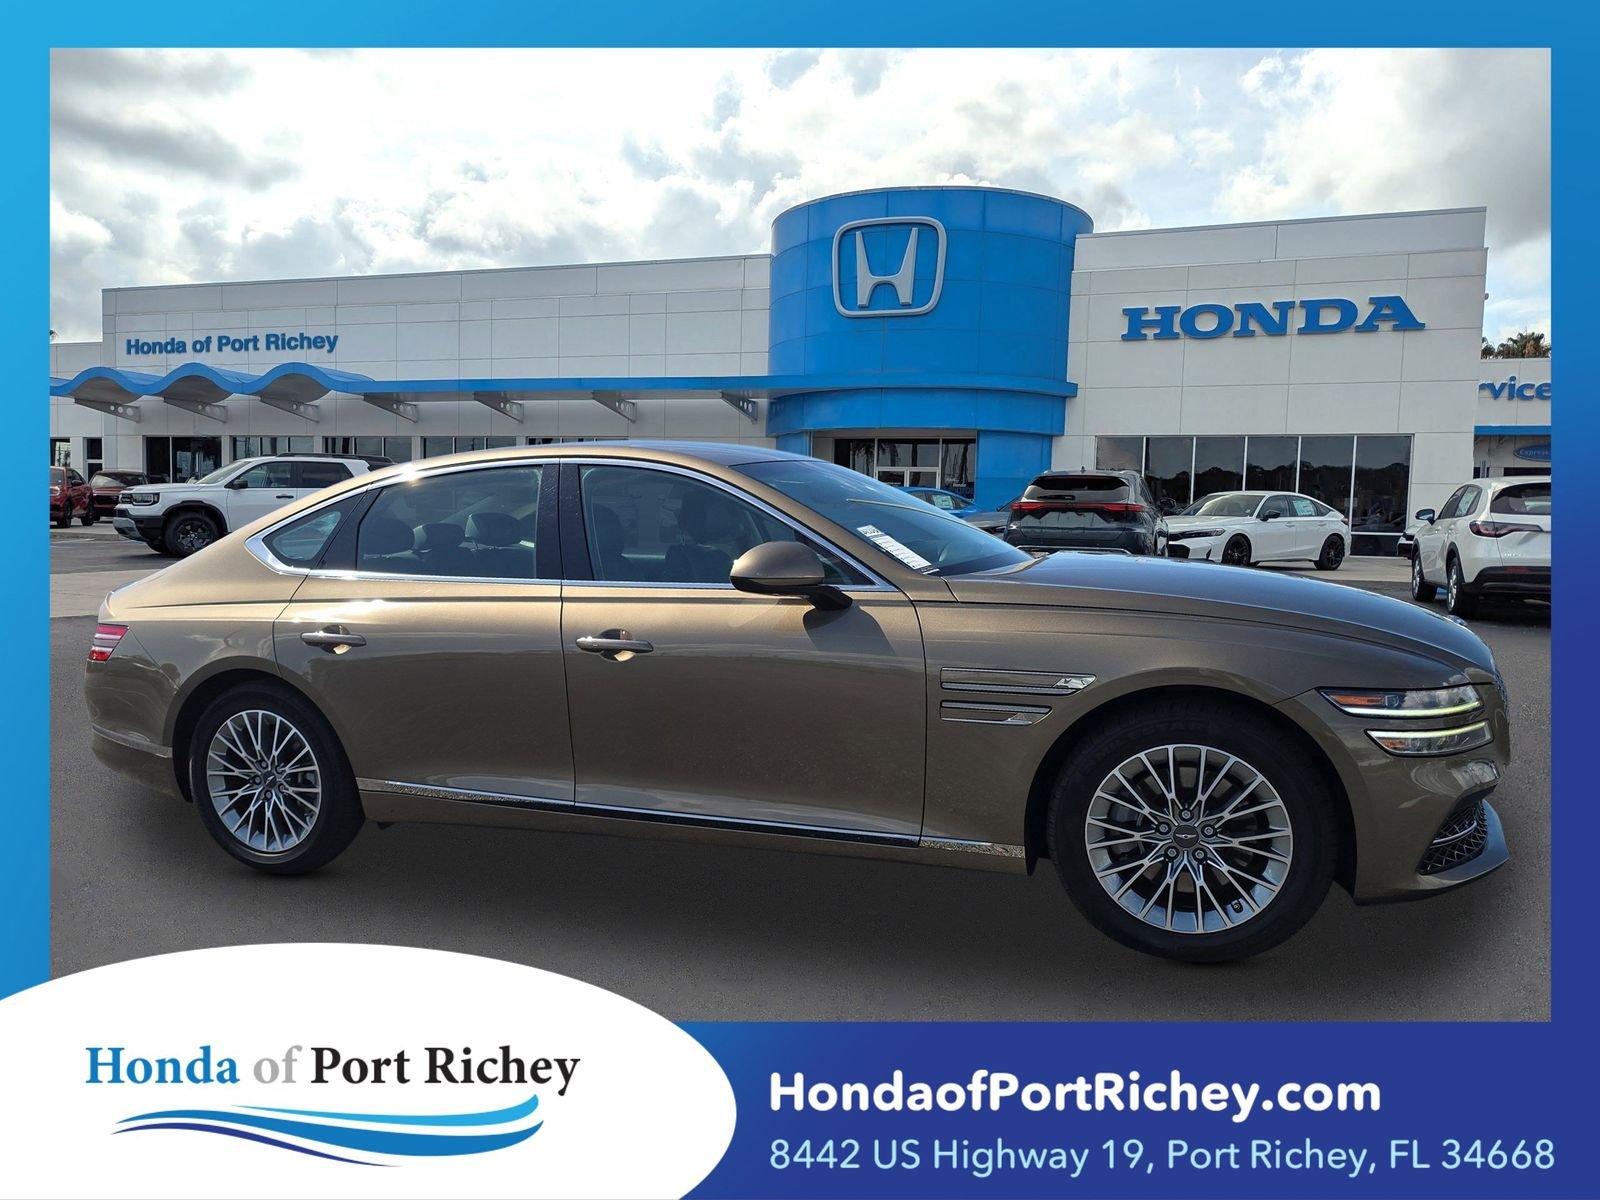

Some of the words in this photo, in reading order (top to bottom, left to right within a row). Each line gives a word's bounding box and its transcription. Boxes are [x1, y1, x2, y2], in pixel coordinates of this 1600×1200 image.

[1121, 296, 1426, 341] HONDA
[125, 337, 187, 355] Honda
[191, 335, 213, 353] of
[217, 334, 259, 352] Port
[265, 331, 339, 353] Richey
